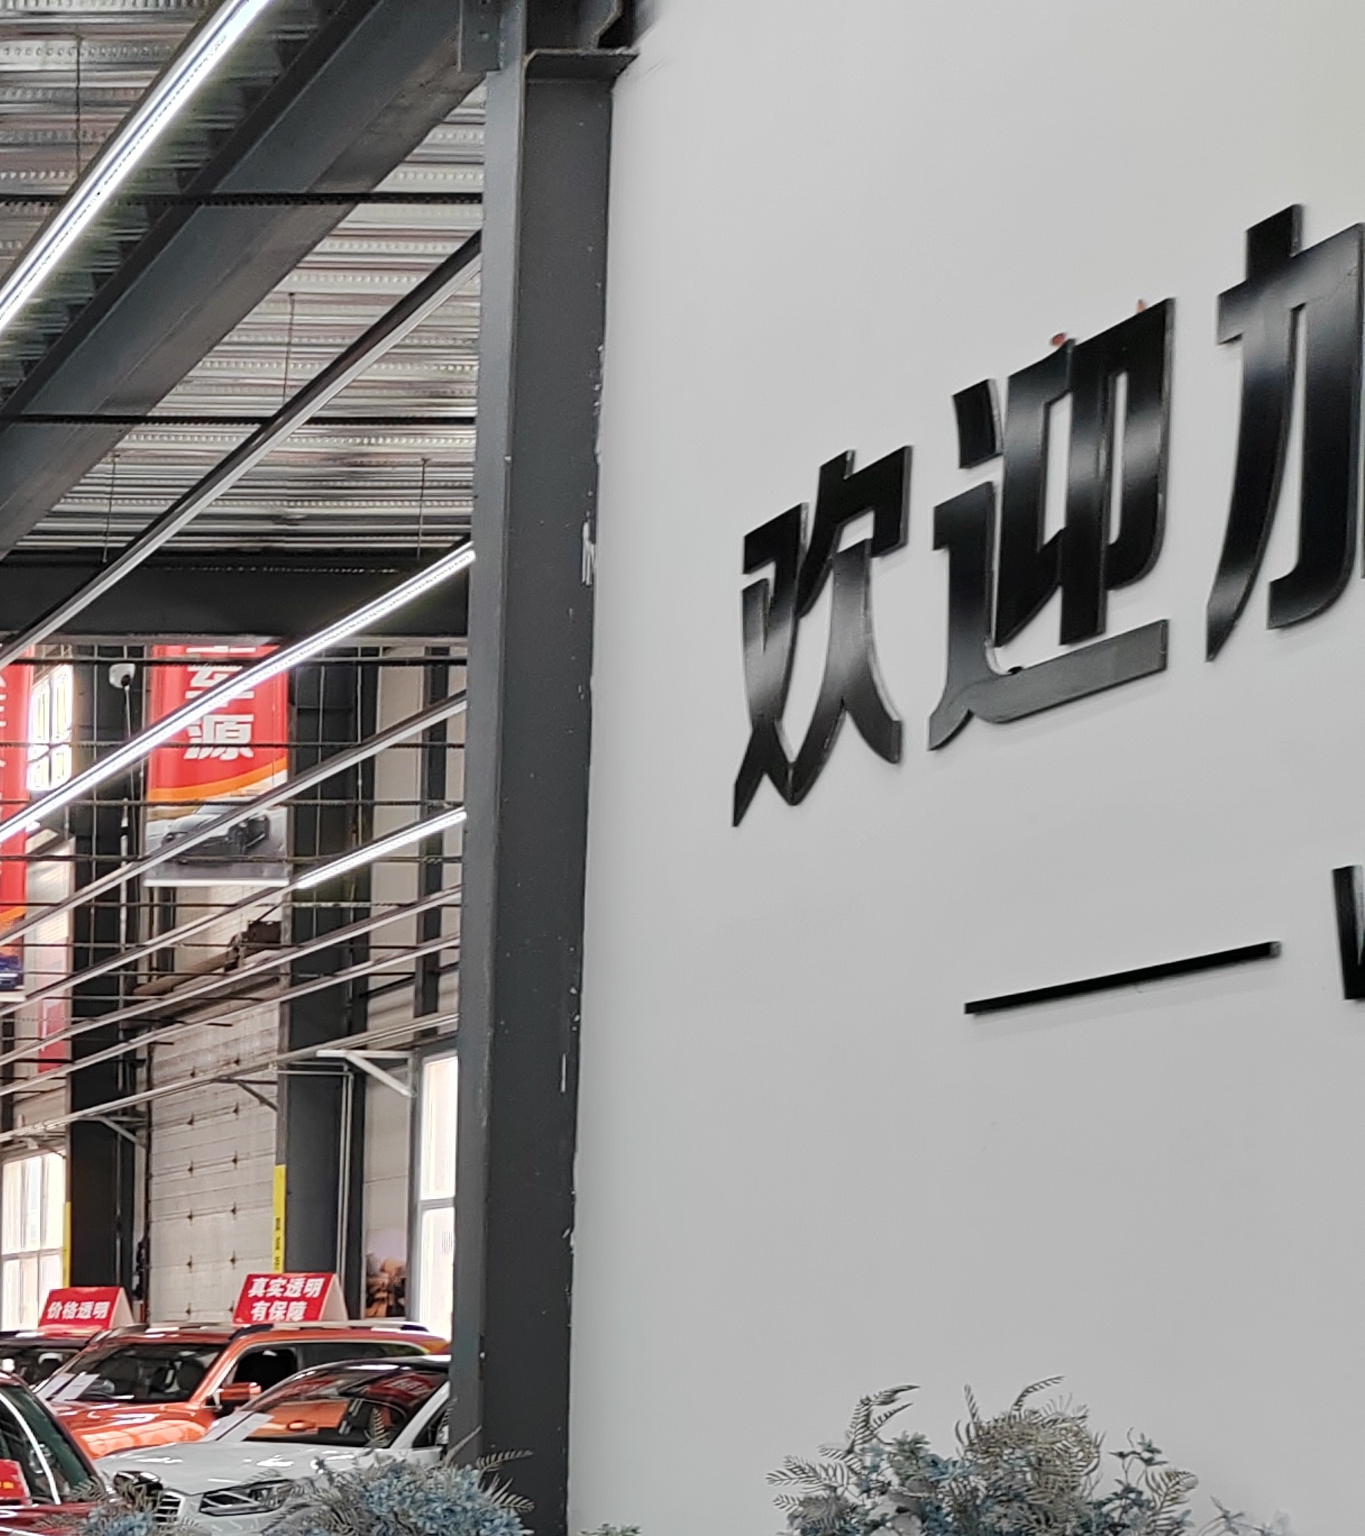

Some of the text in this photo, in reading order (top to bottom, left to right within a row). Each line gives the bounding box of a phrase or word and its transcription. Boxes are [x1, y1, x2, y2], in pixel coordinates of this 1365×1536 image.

[183, 645, 256, 760] 车源
[248, 1277, 325, 1298] 真实透明
[47, 1301, 109, 1320] 价格透明
[251, 1301, 308, 1321] 有保障
